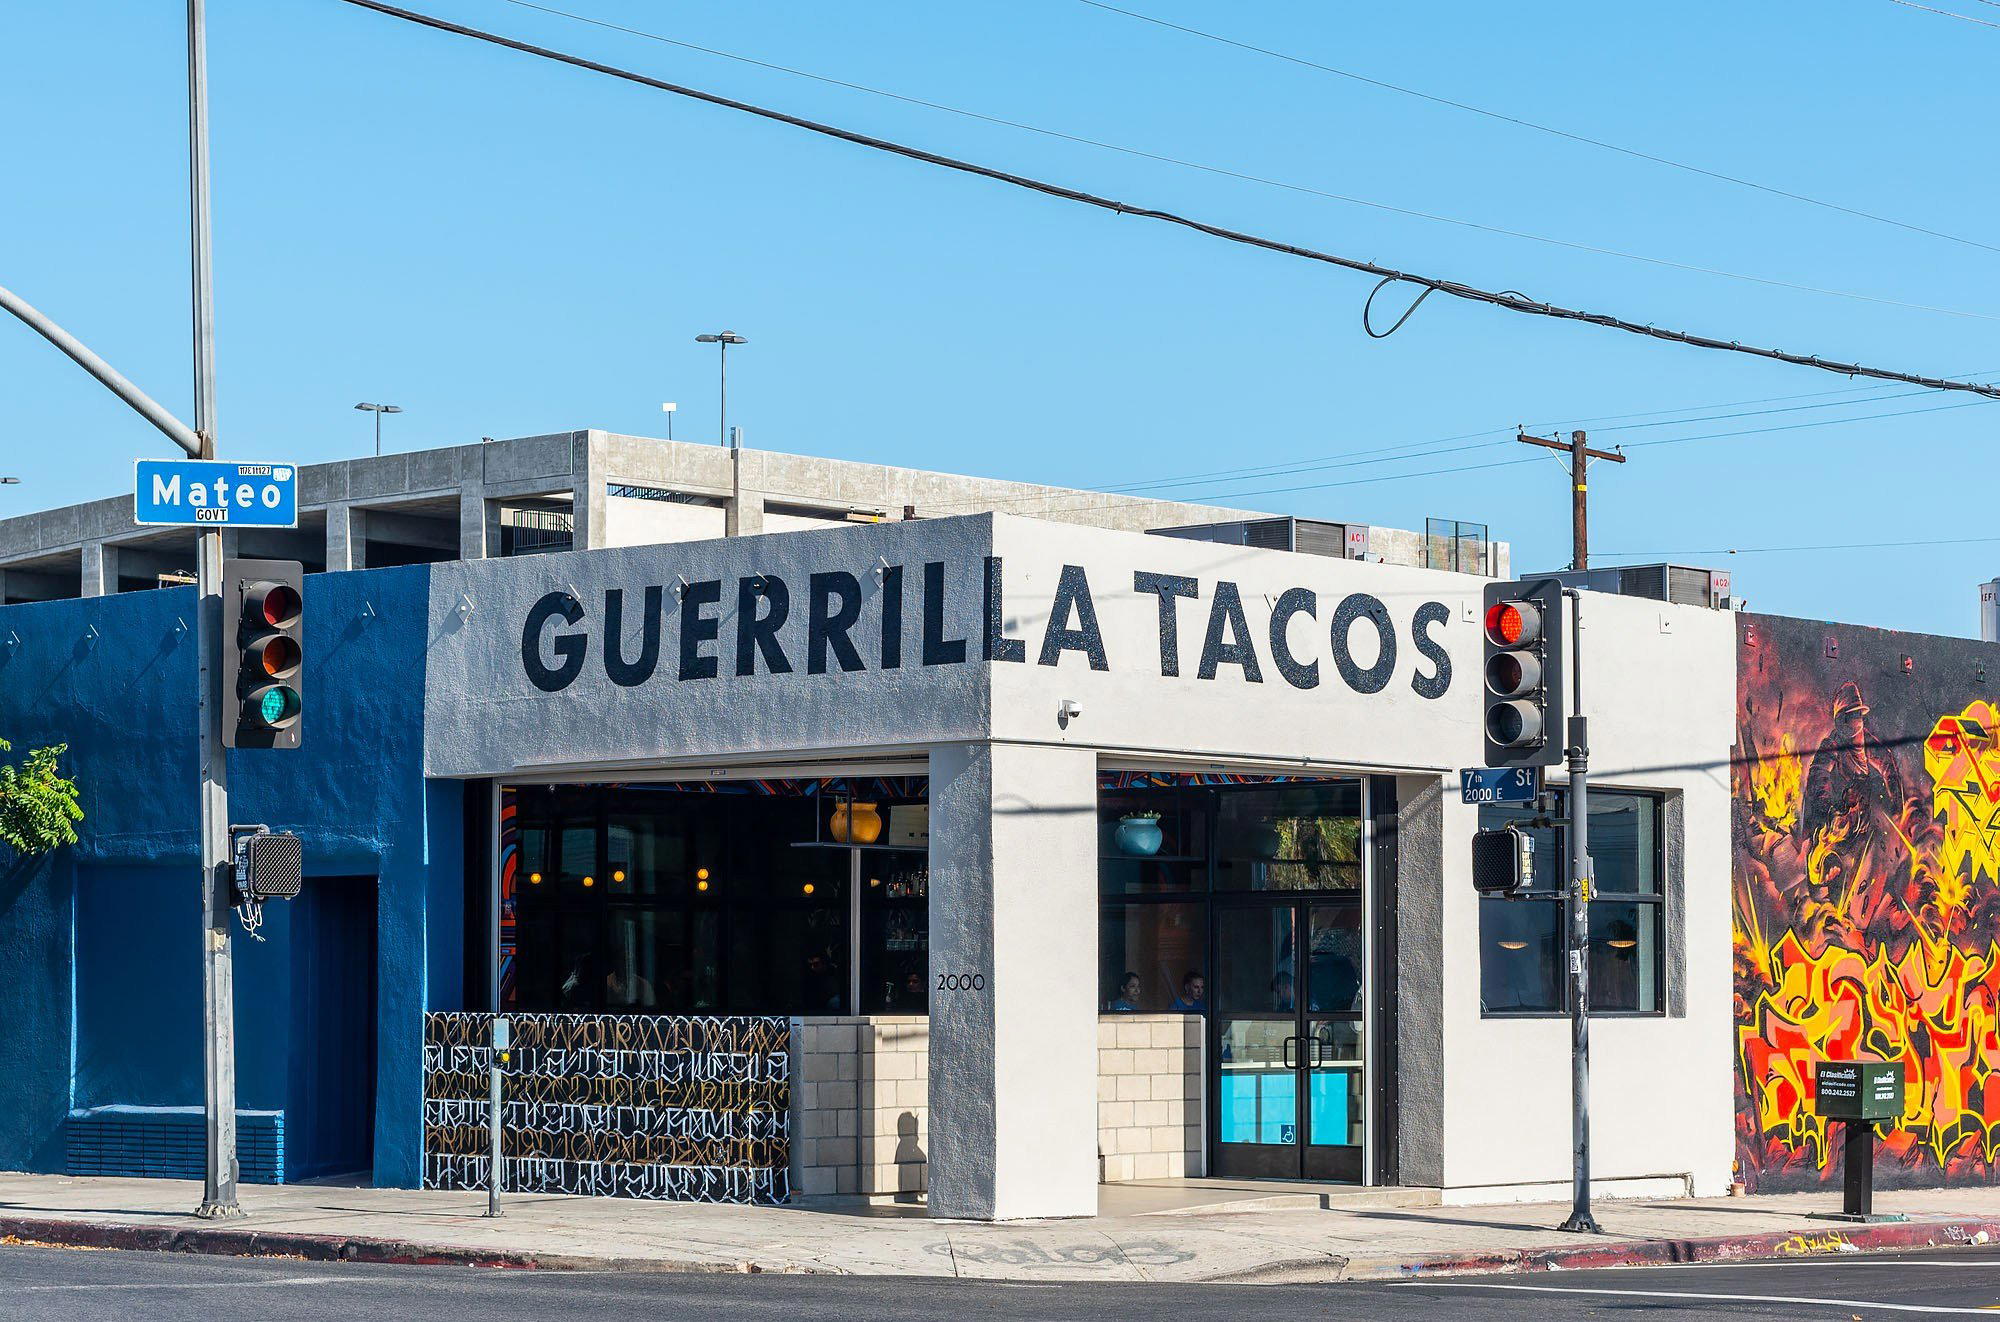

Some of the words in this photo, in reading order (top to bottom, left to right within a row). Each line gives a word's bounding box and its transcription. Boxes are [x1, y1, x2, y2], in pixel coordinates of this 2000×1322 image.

[152, 474, 281, 508] Mateo
[197, 509, 227, 521] GOVT
[521, 555, 1110, 693] GUERRILLA
[1134, 570, 1453, 700] TACOS
[1465, 771, 1483, 789] 7th
[1516, 768, 1532, 787] St
[1465, 788, 1492, 801] 2000
[1497, 788, 1503, 800] E
[938, 974, 985, 991] 2000
